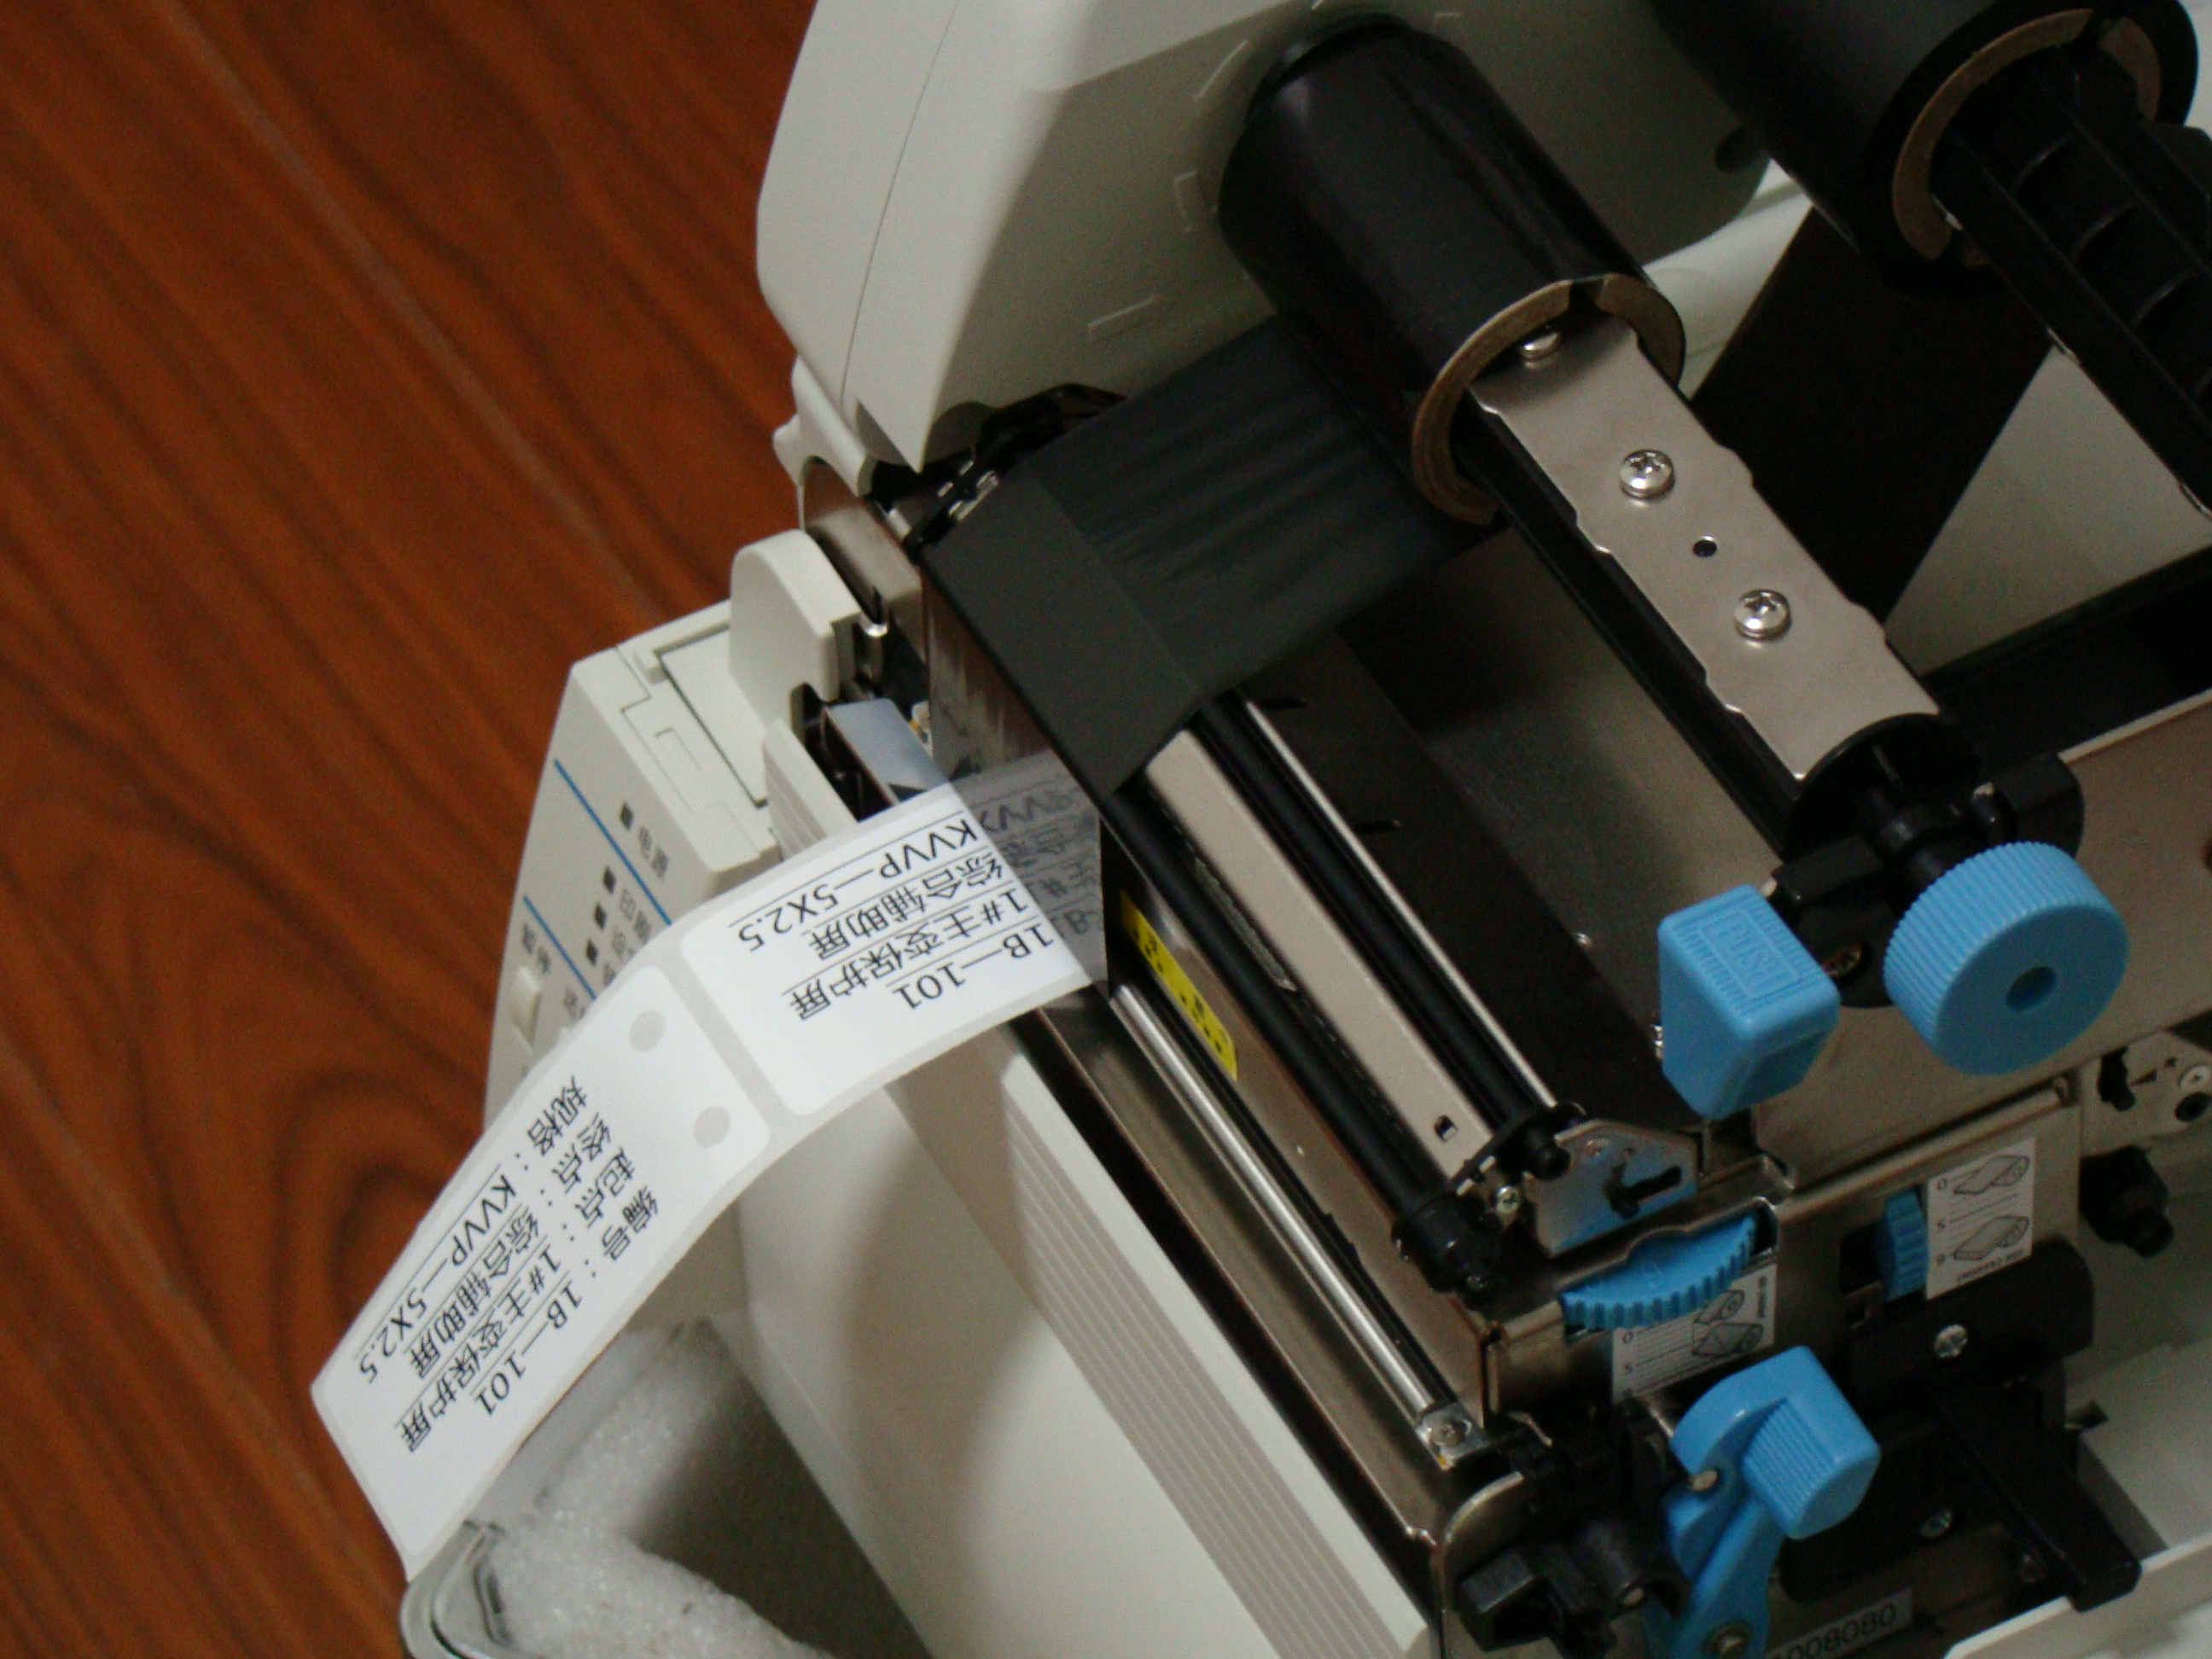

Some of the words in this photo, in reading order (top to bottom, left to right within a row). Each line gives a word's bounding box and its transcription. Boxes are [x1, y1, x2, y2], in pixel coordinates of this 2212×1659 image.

[789, 888, 1028, 1021] 1#主变保护屏
[807, 852, 1004, 960] 综合辅助屏
[399, 1245, 562, 1452] 1#主变保护屏
[408, 1205, 539, 1379] 综合辅助屏
[1773, 1603, 1896, 1659] 008080
